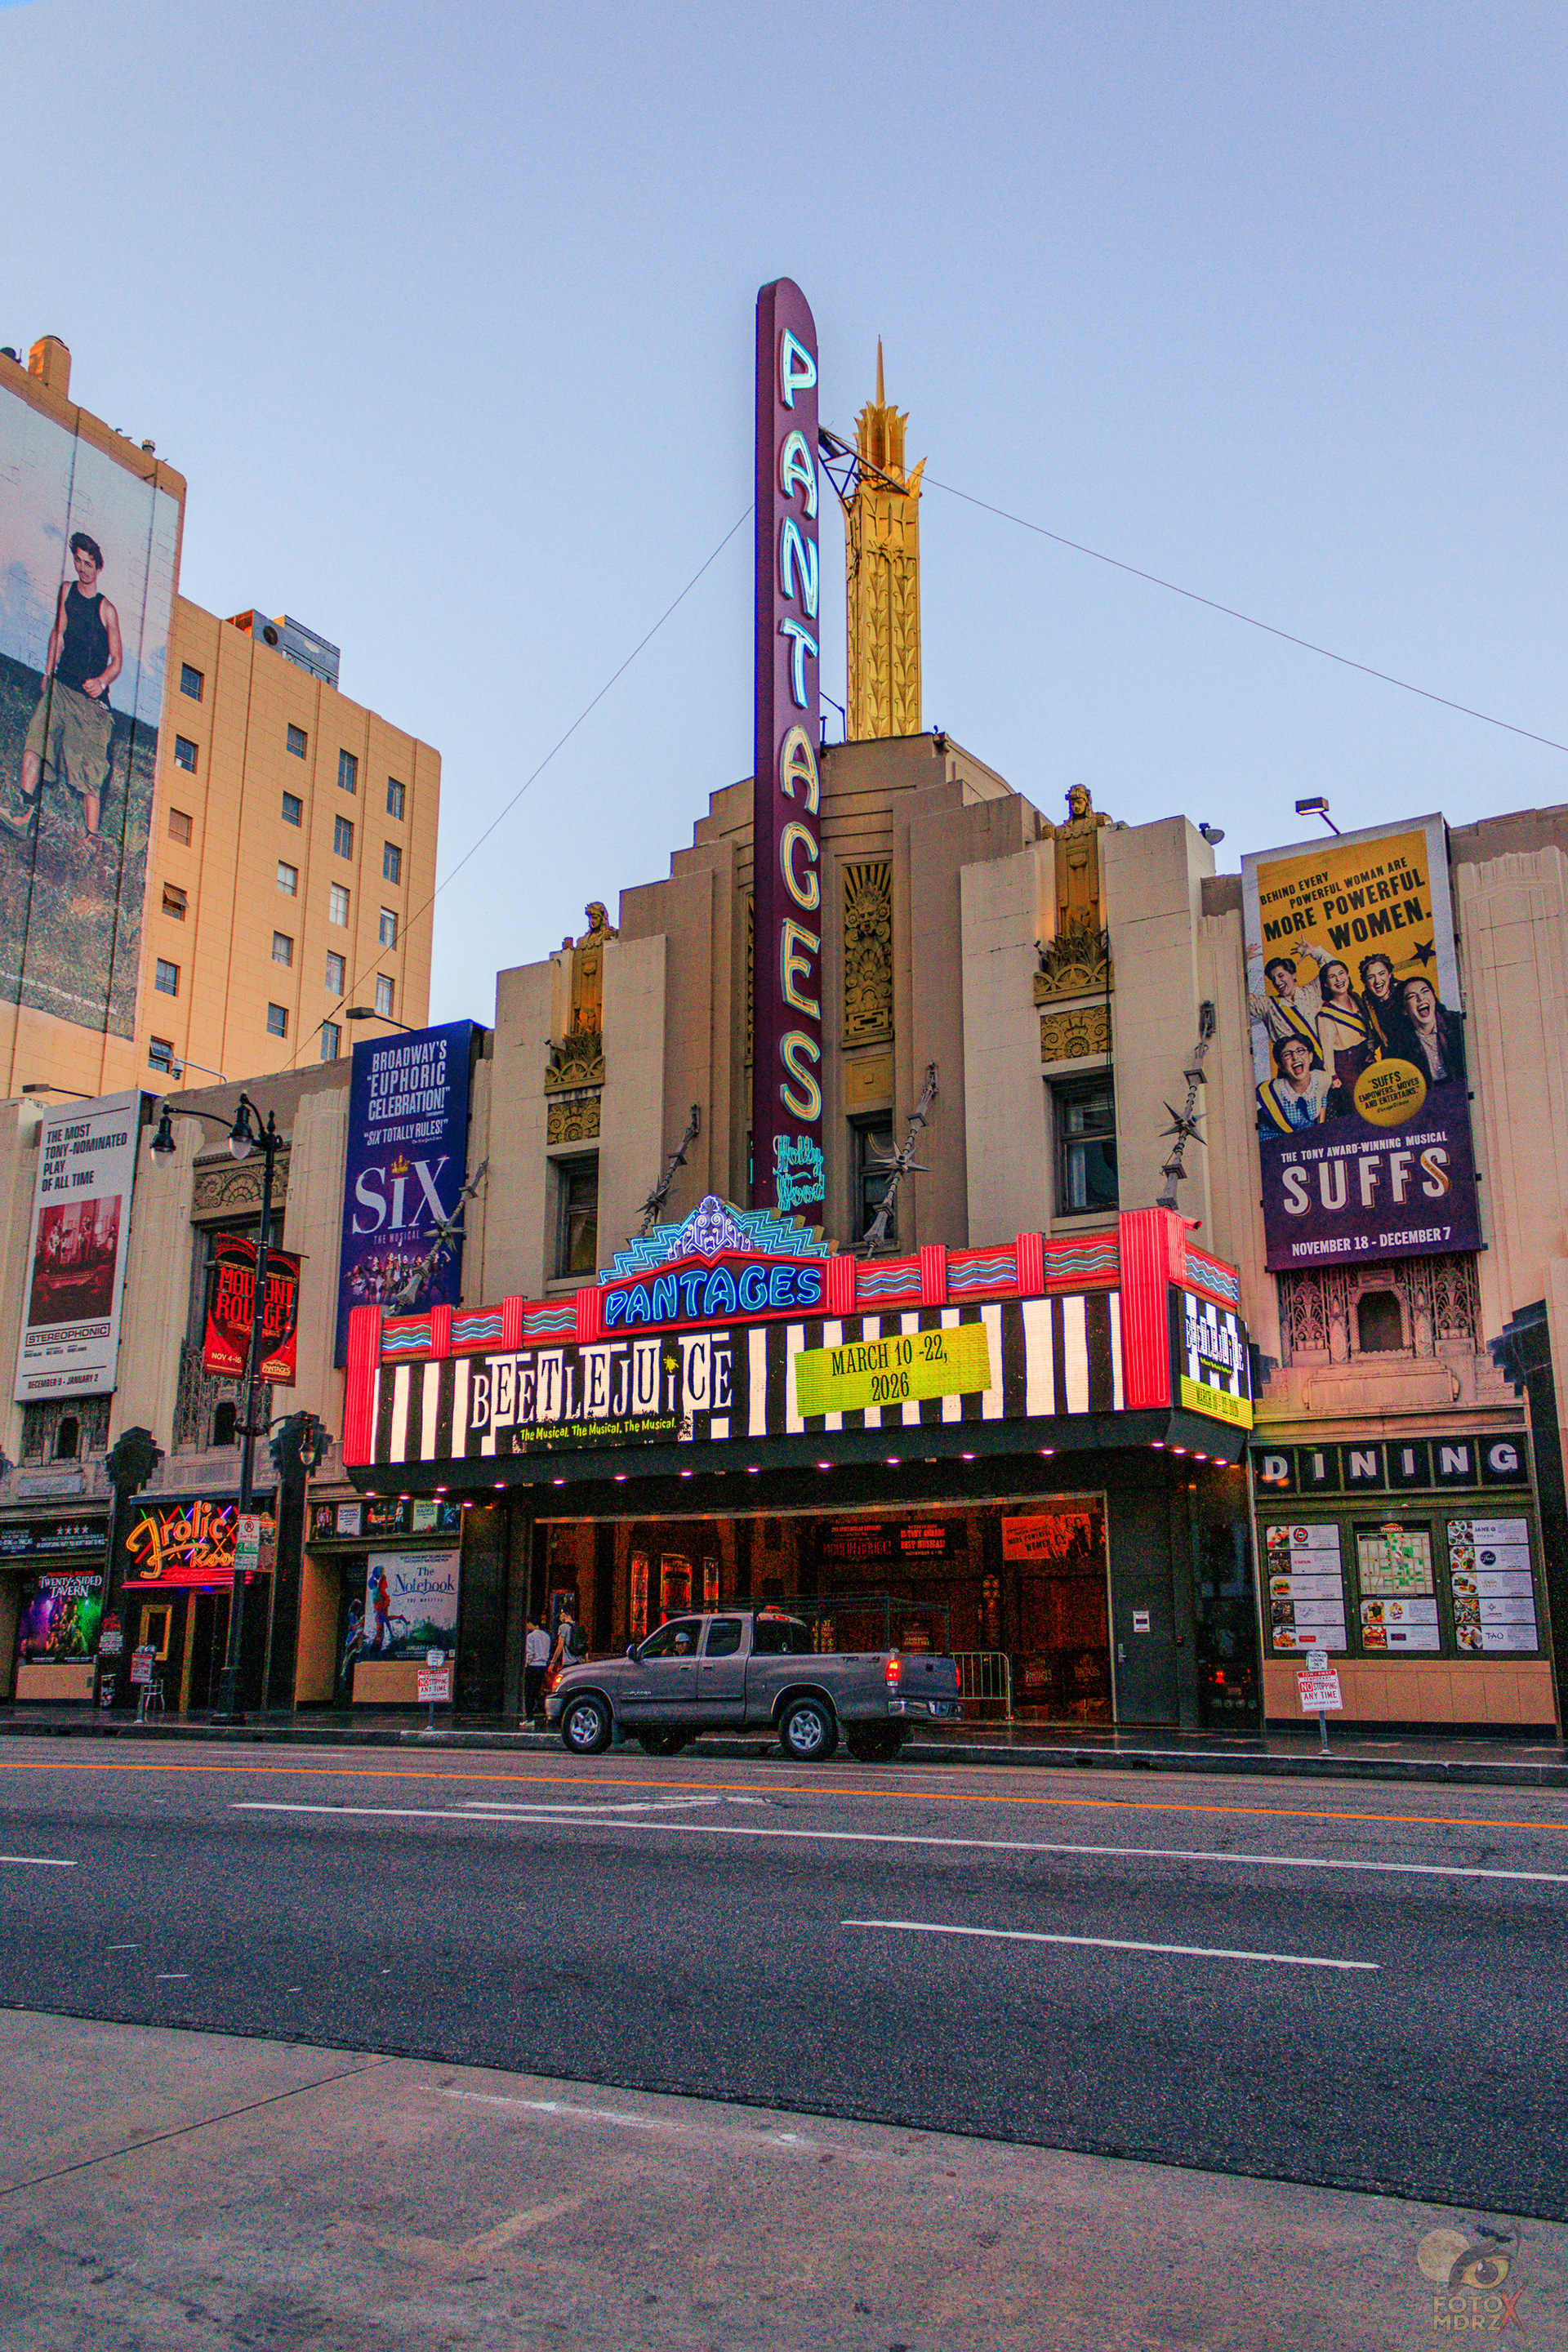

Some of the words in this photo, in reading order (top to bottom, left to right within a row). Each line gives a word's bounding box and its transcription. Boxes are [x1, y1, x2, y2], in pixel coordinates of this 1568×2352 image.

[780, 327, 822, 1122] PANTAGES
[1260, 884, 1296, 906] BEHIND
[1298, 871, 1329, 892] EVERY
[1290, 881, 1342, 909] POWERFUL
[1344, 866, 1384, 888] WOMAN
[1388, 857, 1408, 874] ARE
[1263, 906, 1317, 942] MORE
[1323, 868, 1426, 920] POWERFUL
[1327, 897, 1432, 951] WOMEN.
[372, 1040, 447, 1072] BROADWAY'S
[367, 1061, 446, 1098] “EUPHORIC
[1396, 1077, 1419, 1090] MOVES
[368, 1086, 450, 1121] CELEBRATION!”
[1365, 1099, 1378, 1110] AND
[45, 1132, 127, 1160] TONY-NOMINATED
[47, 1129, 62, 1143] THE
[65, 1123, 91, 1141] MOST
[364, 1128, 381, 1146] “SIX
[382, 1124, 414, 1143] TOTALLY
[415, 1118, 448, 1138] RULES!”
[1281, 1152, 1298, 1164] THE
[1301, 1147, 1325, 1160] TONY
[1405, 1131, 1448, 1147] MUSICAL
[42, 1178, 53, 1192] OF
[54, 1175, 69, 1190] ALL
[72, 1170, 95, 1187] TIME
[43, 1160, 65, 1176] PLAY
[1282, 1147, 1450, 1216] SUFFS
[373, 1235, 386, 1245] THE
[389, 1230, 420, 1242] MUSICAL
[1292, 1237, 1351, 1257] NOVEMBER
[1354, 1236, 1369, 1250] 18
[1379, 1227, 1441, 1248] DECEMBER
[1442, 1227, 1451, 1241] 7
[605, 1265, 822, 1325] PANTAGES
[29, 1326, 107, 1343] STEREOPHONIC
[212, 1352, 227, 1361] NOV
[228, 1354, 242, 1364] 4-16
[831, 1343, 889, 1376] MARCH
[894, 1339, 912, 1366] 10
[28, 1378, 57, 1389] DECEMBER
[58, 1378, 63, 1386] 9
[66, 1374, 93, 1385] JANUARY
[94, 1374, 99, 1382] 2
[470, 1342, 733, 1428] BEETLEJUICE
[871, 1371, 910, 1401] 2026
[520, 1429, 535, 1441] The
[572, 1424, 587, 1437] The
[589, 1423, 622, 1436] Musical.
[624, 1420, 639, 1433] The
[641, 1417, 676, 1431] Musical.
[1264, 1443, 1518, 1481] DINING
[126, 1500, 227, 1579] Frolic
[38, 1575, 102, 1588] TWENTY-SIDED
[394, 1574, 455, 1593] Notebook
[416, 1566, 434, 1576] The
[50, 1584, 89, 1598] TAVERN
[1301, 1682, 1312, 1691] NO
[1313, 1682, 1337, 1691] STOPPING
[1304, 1691, 1318, 1700] ANY
[1321, 1690, 1337, 1699] TIME
